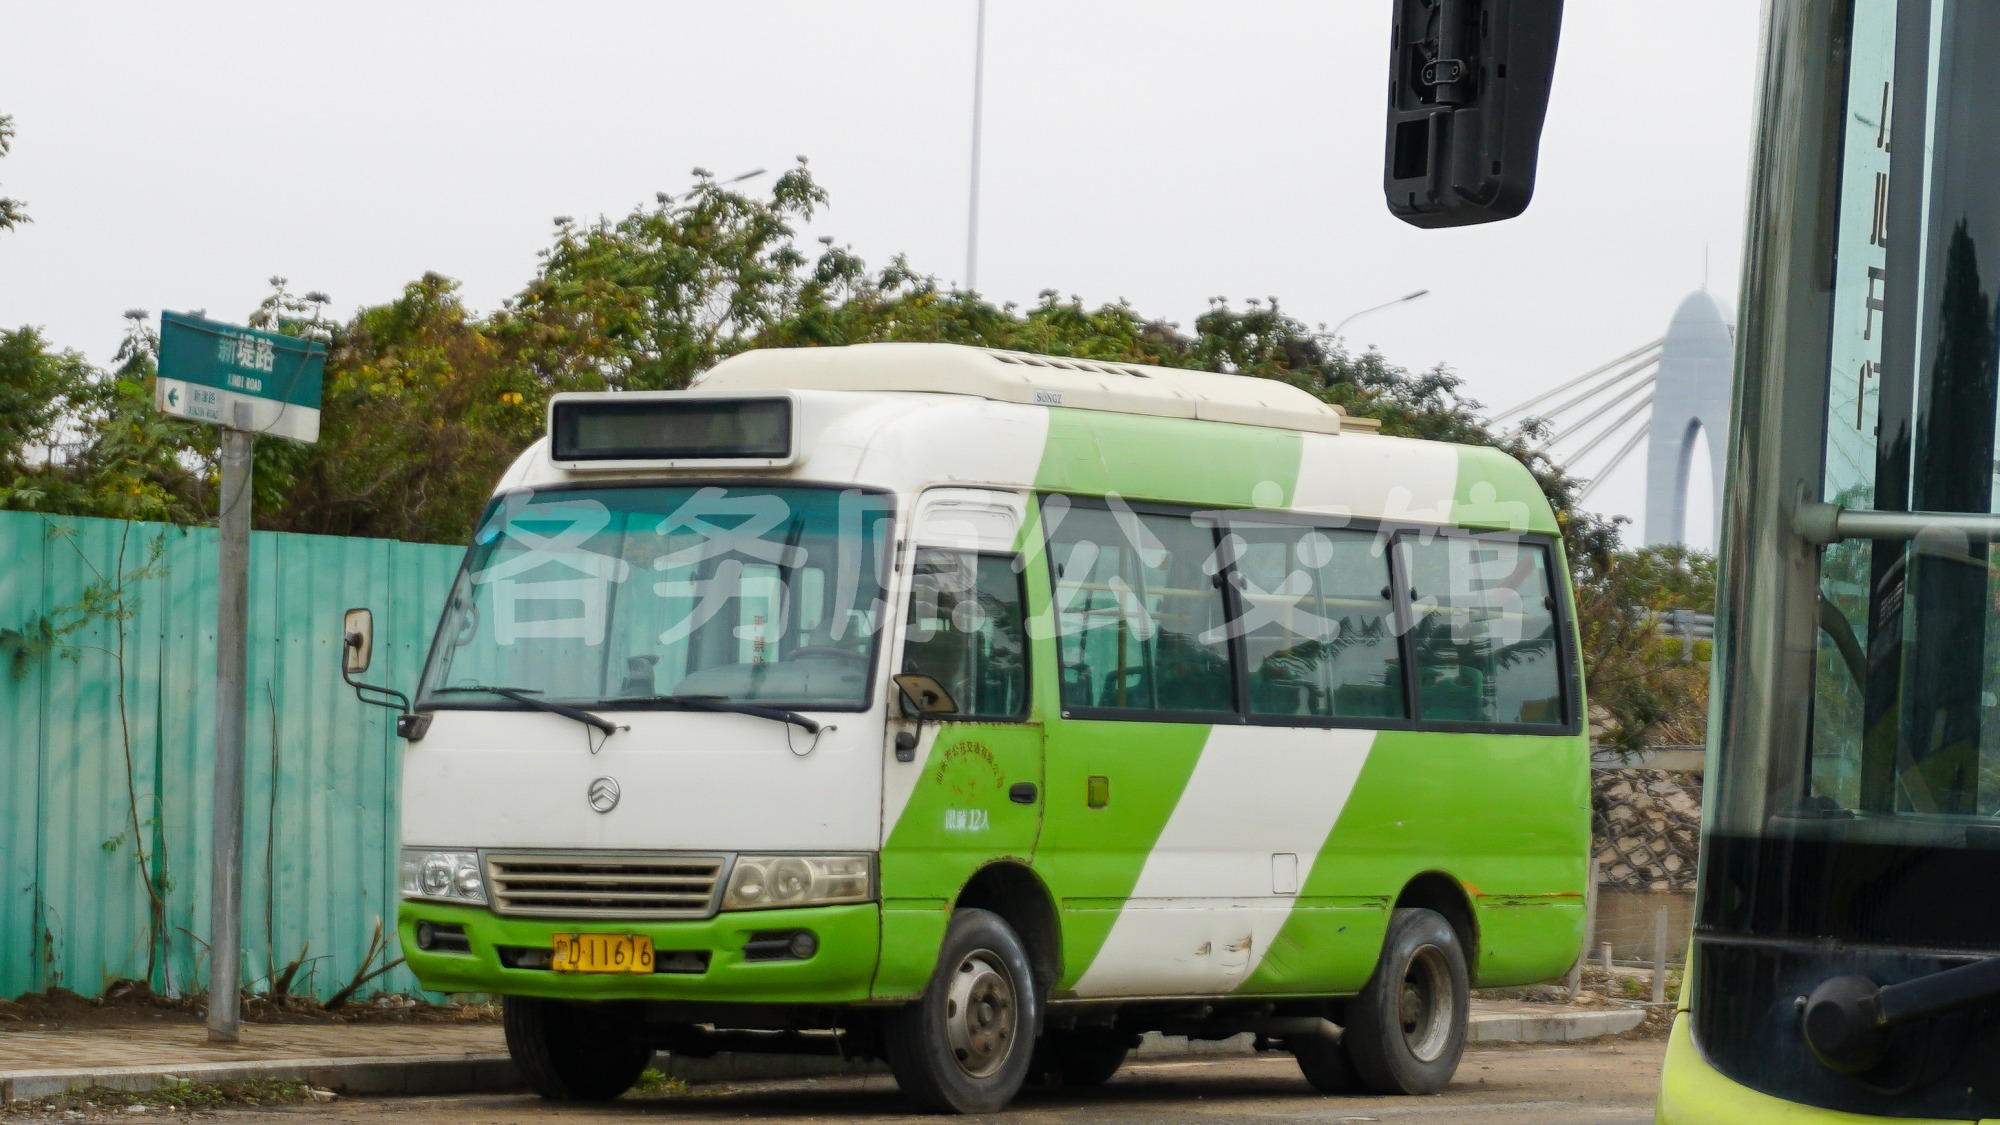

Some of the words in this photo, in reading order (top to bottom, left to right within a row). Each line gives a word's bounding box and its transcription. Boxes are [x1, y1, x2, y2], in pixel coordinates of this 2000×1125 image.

[218, 329, 275, 372] 新堤路
[246, 378, 262, 391] ROAD
[1036, 391, 1062, 404] SONGZ
